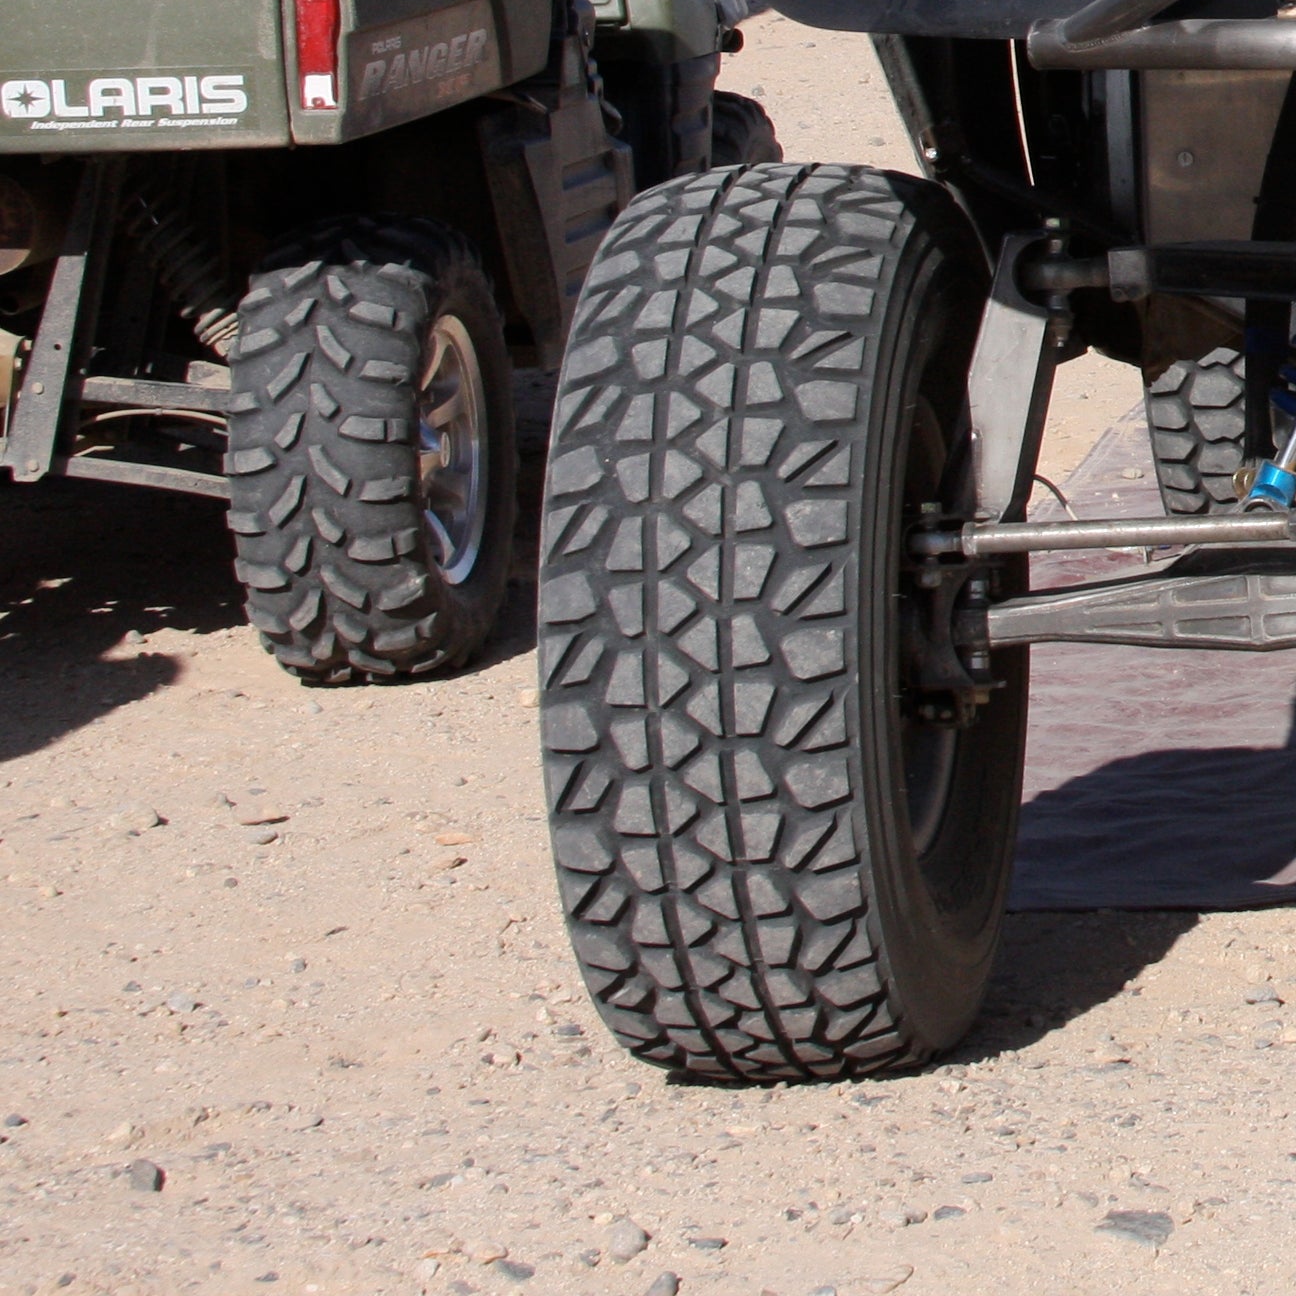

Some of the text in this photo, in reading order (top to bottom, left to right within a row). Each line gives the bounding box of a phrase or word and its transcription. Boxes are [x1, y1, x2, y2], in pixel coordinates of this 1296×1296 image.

[358, 28, 488, 101] RANGER
[30, 116, 238, 131] Independent Rear Suspension
